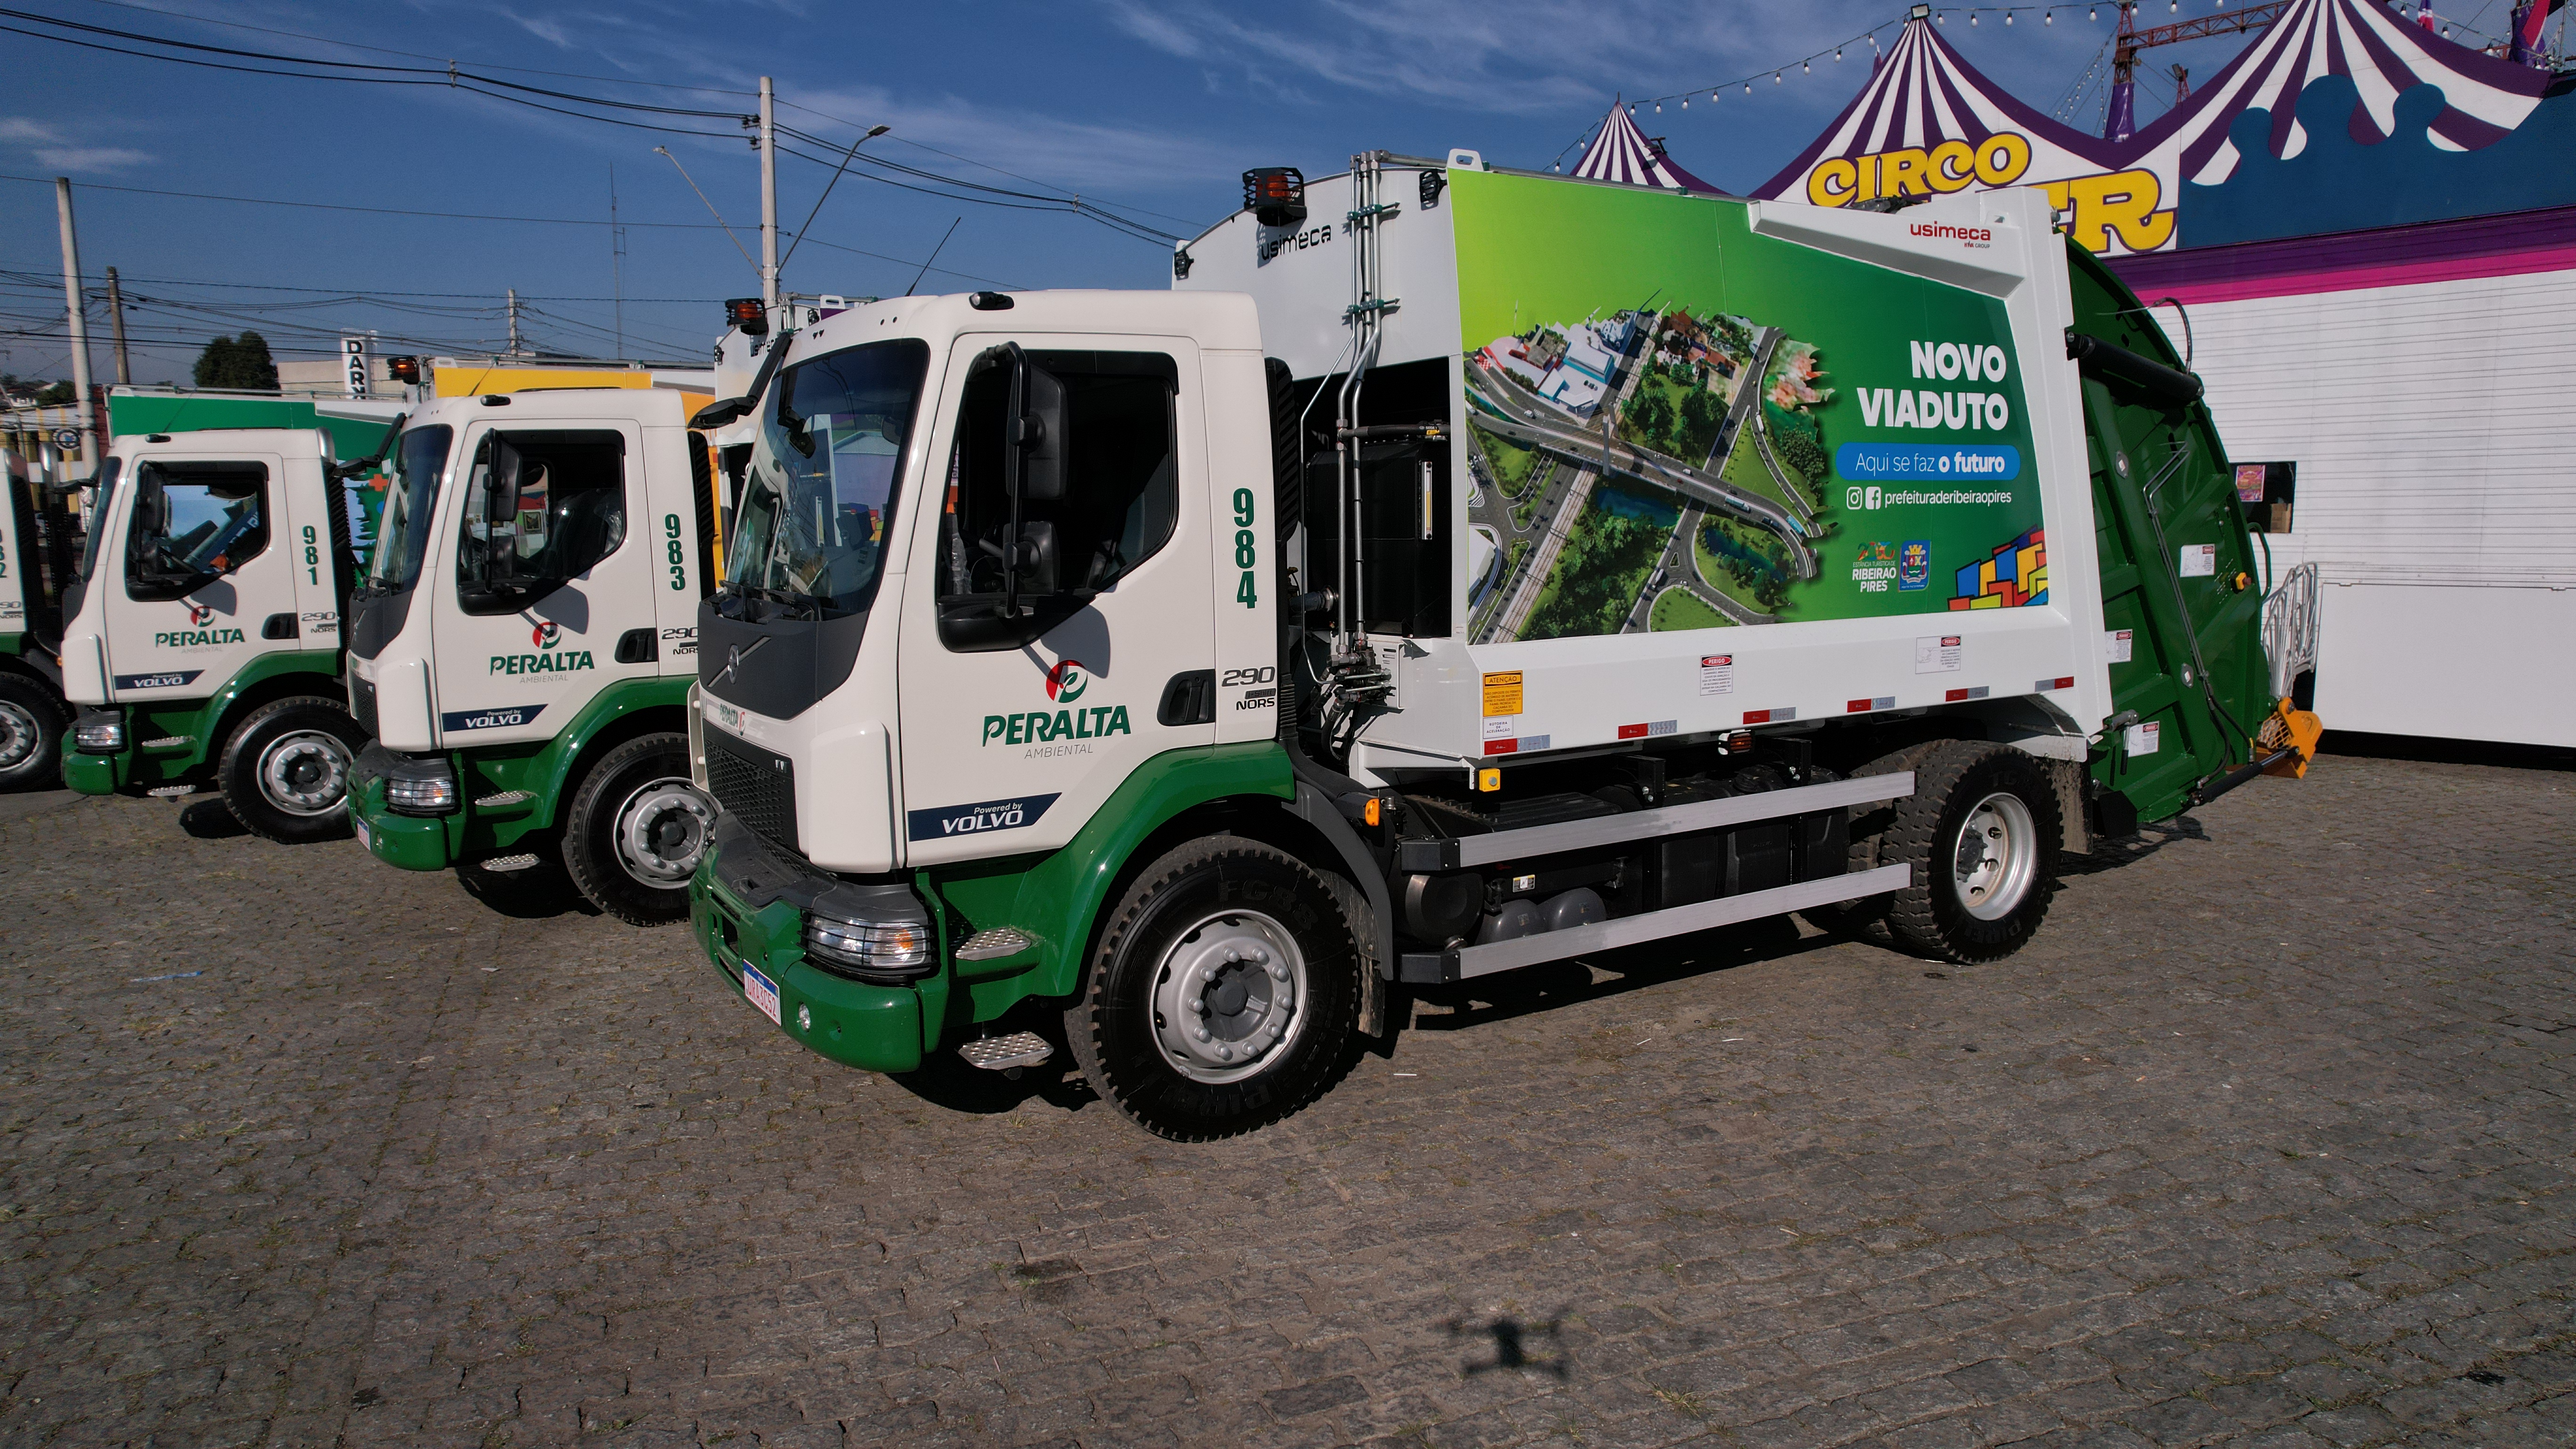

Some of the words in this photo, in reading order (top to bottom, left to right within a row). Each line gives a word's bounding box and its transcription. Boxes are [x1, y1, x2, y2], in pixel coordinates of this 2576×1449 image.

[1807, 131, 2032, 208] CIRCO
[1910, 220, 1991, 241] usimeca
[1261, 224, 1332, 260] usimeca
[1910, 340, 2006, 382] NOVO
[1856, 387, 2008, 430] VIADUTO
[1855, 452, 1889, 477] Aqui
[1893, 456, 1910, 471] se
[1914, 453, 1935, 472] faz
[1939, 456, 1950, 473] o
[1954, 451, 2005, 473] futuro
[1885, 490, 2012, 508] prefeituraderibeiraopires
[302, 525, 319, 586] 981
[665, 513, 686, 591] 983
[1233, 487, 1257, 609] 984
[1860, 580, 1888, 592] PIRES
[301, 612, 336, 621] 290
[155, 628, 245, 648] PERALTA
[181, 646, 223, 654] AMBIENTAL
[490, 650, 595, 676] PERALTA
[133, 677, 183, 687] VOLVO
[519, 674, 568, 684] AMBIENTAL
[1222, 666, 1275, 687] 290
[1489, 675, 1517, 683] ATENÇÃO
[1236, 698, 1275, 710] NORS
[465, 714, 522, 728] VOLVO
[719, 703, 739, 728] PERALTA
[982, 705, 1131, 747] PERALTA
[1024, 743, 1094, 759] AMBIENTAL
[974, 803, 1011, 814] Powered
[942, 810, 1023, 833] VOLVO
